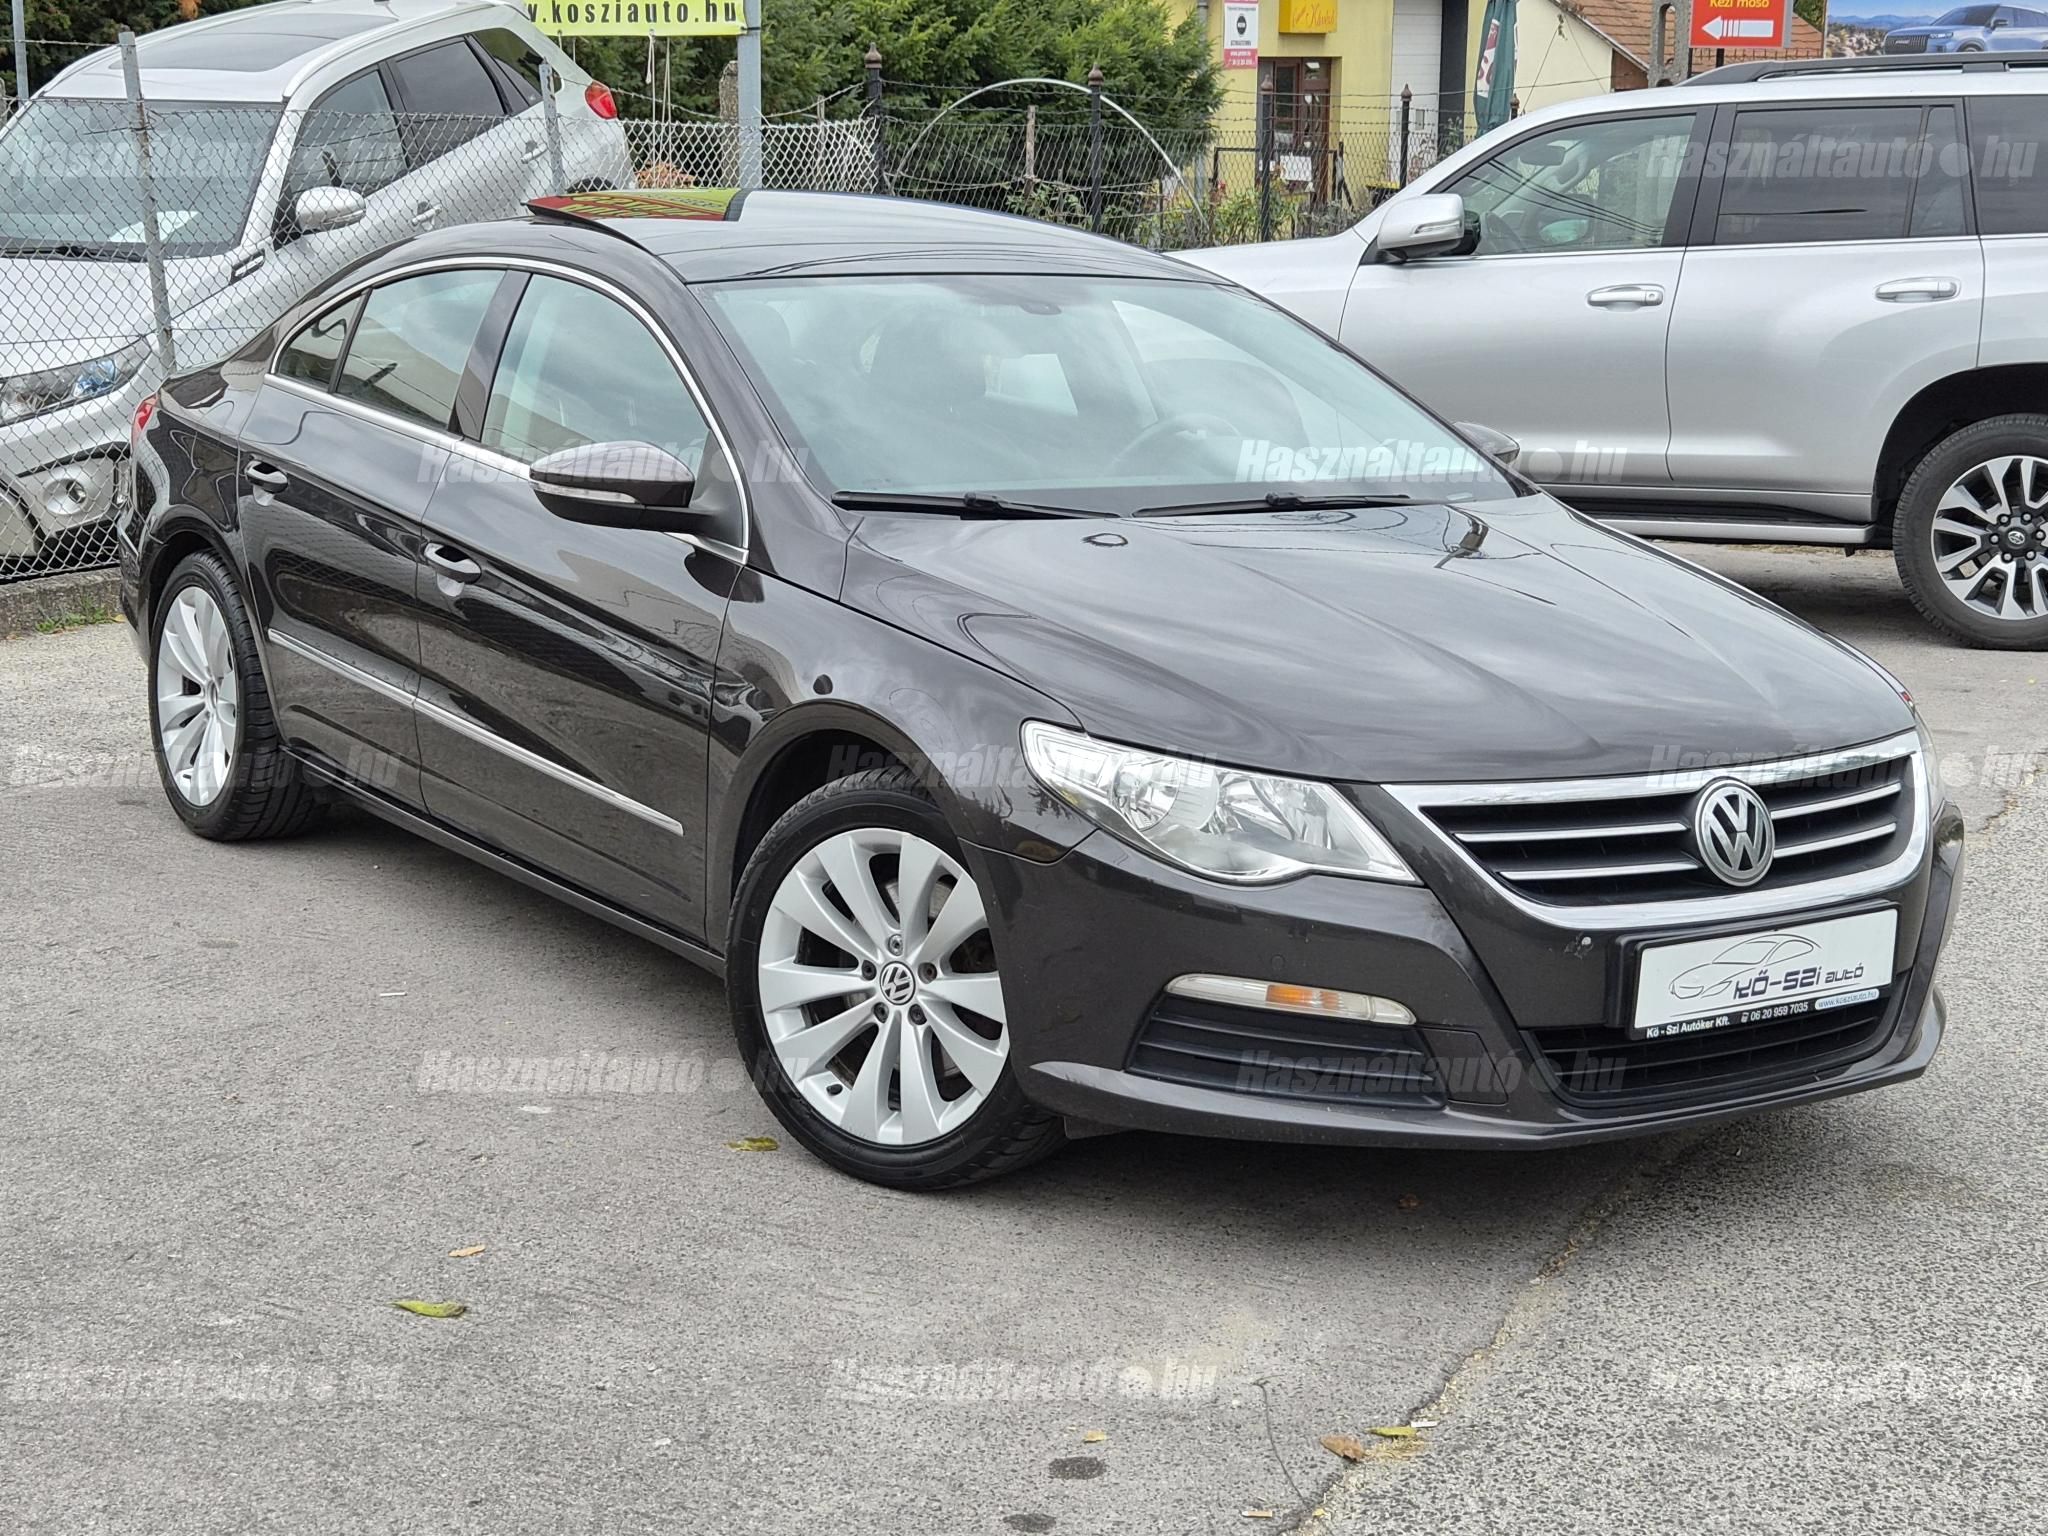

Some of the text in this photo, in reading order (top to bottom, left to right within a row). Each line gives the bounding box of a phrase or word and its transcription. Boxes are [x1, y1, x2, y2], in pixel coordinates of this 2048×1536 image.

[1681, 1019, 1714, 1033] Autóker
[1715, 1015, 1730, 1028] Kft.
[1750, 1010, 1761, 1021] 06
[1761, 1008, 1772, 1020] 20
[1773, 1005, 1788, 1018] 959
[1789, 1002, 1809, 1015] 7035
